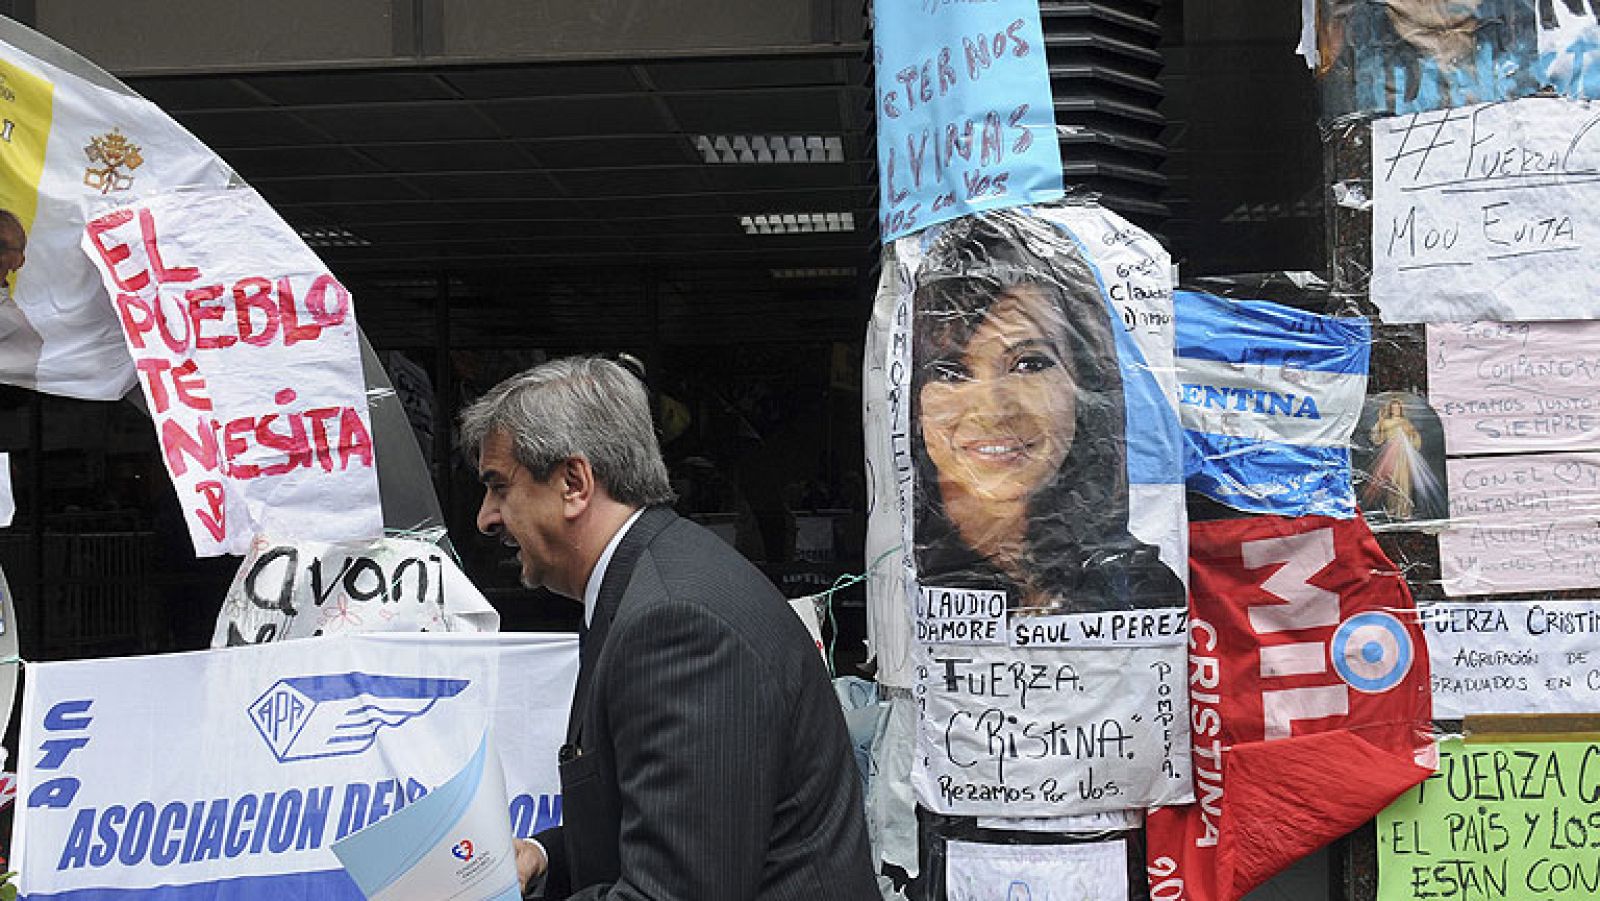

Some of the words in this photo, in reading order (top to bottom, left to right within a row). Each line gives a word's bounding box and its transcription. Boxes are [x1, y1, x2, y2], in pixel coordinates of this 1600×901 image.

[86, 209, 203, 292] EL
[116, 273, 350, 354] PUEBLO
[1015, 621, 1072, 647] SAUL
[1110, 611, 1189, 641] PEREZ
[1240, 527, 1349, 742] MIL
[1187, 617, 1227, 849] CRISTINA
[55, 784, 335, 871] ASOCIACION
[1391, 820, 1432, 856] EL
[1523, 811, 1541, 849] Y
